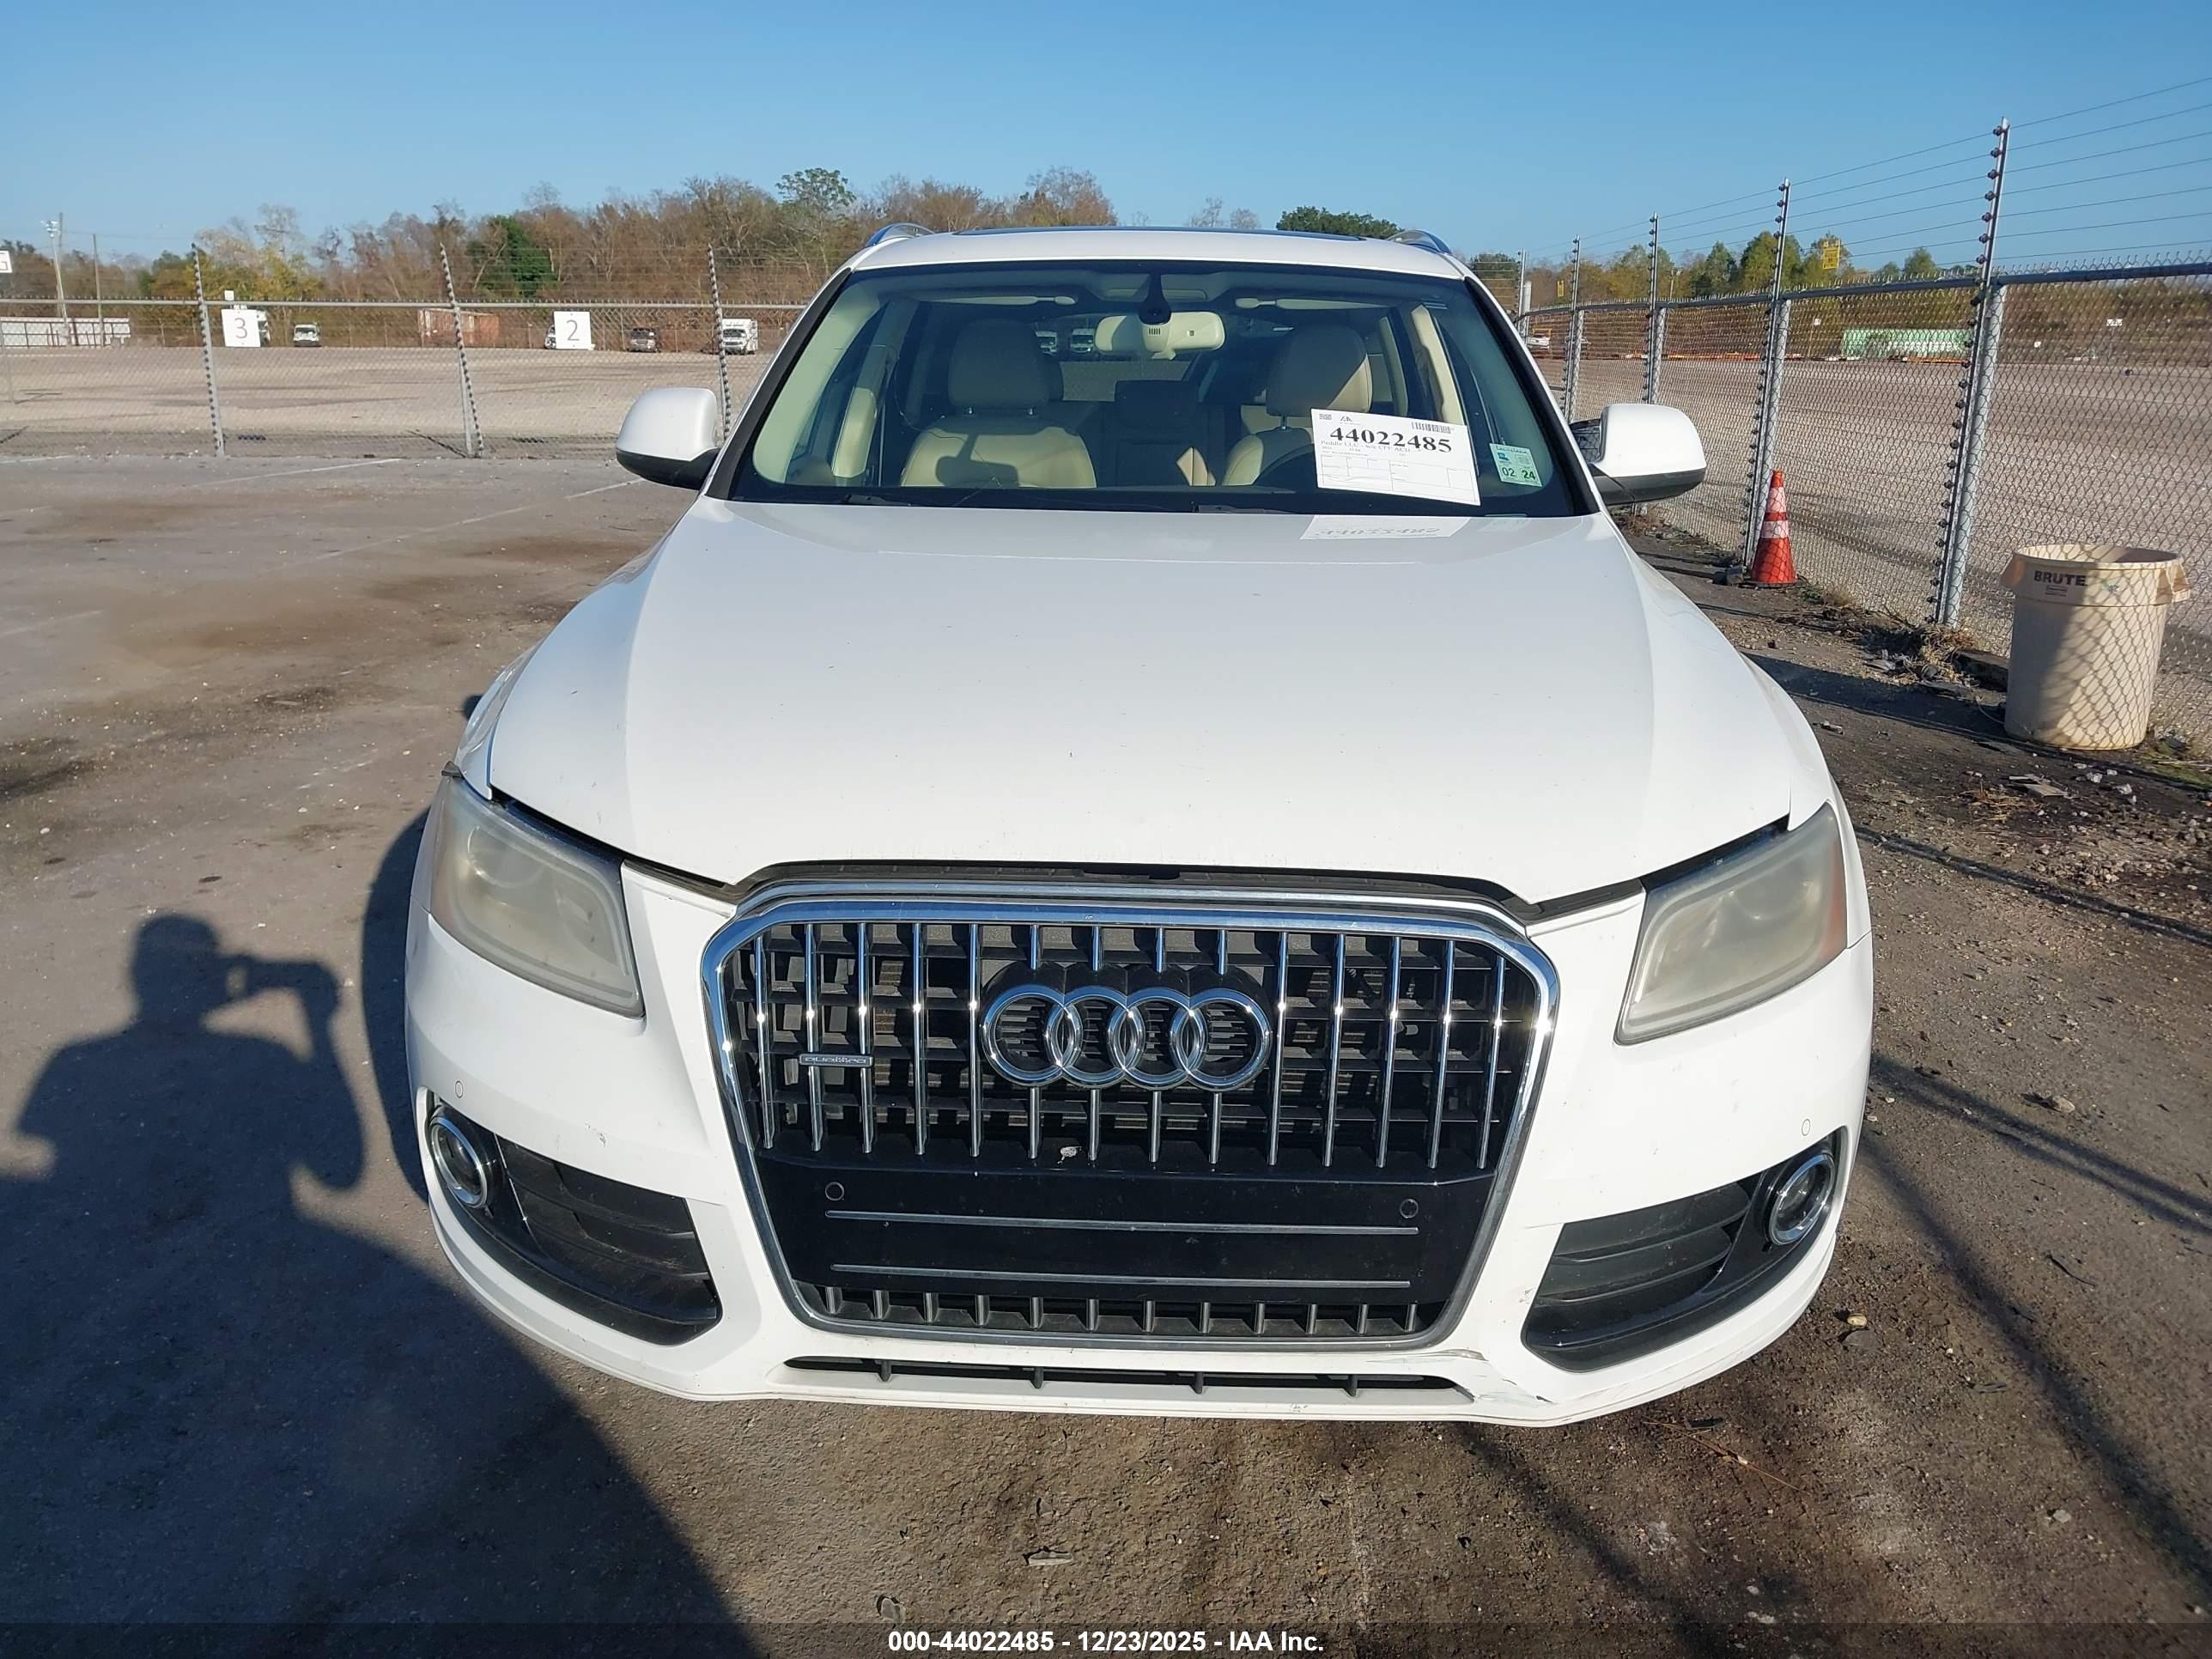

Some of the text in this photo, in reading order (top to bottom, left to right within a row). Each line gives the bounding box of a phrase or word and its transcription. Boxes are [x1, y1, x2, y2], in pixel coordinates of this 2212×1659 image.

[234, 317, 248, 339] 3
[566, 319, 580, 341] 2
[1329, 427, 1452, 453] 44022485
[1501, 466, 1536, 480] 02 24
[805, 1055, 866, 1066] quattro
